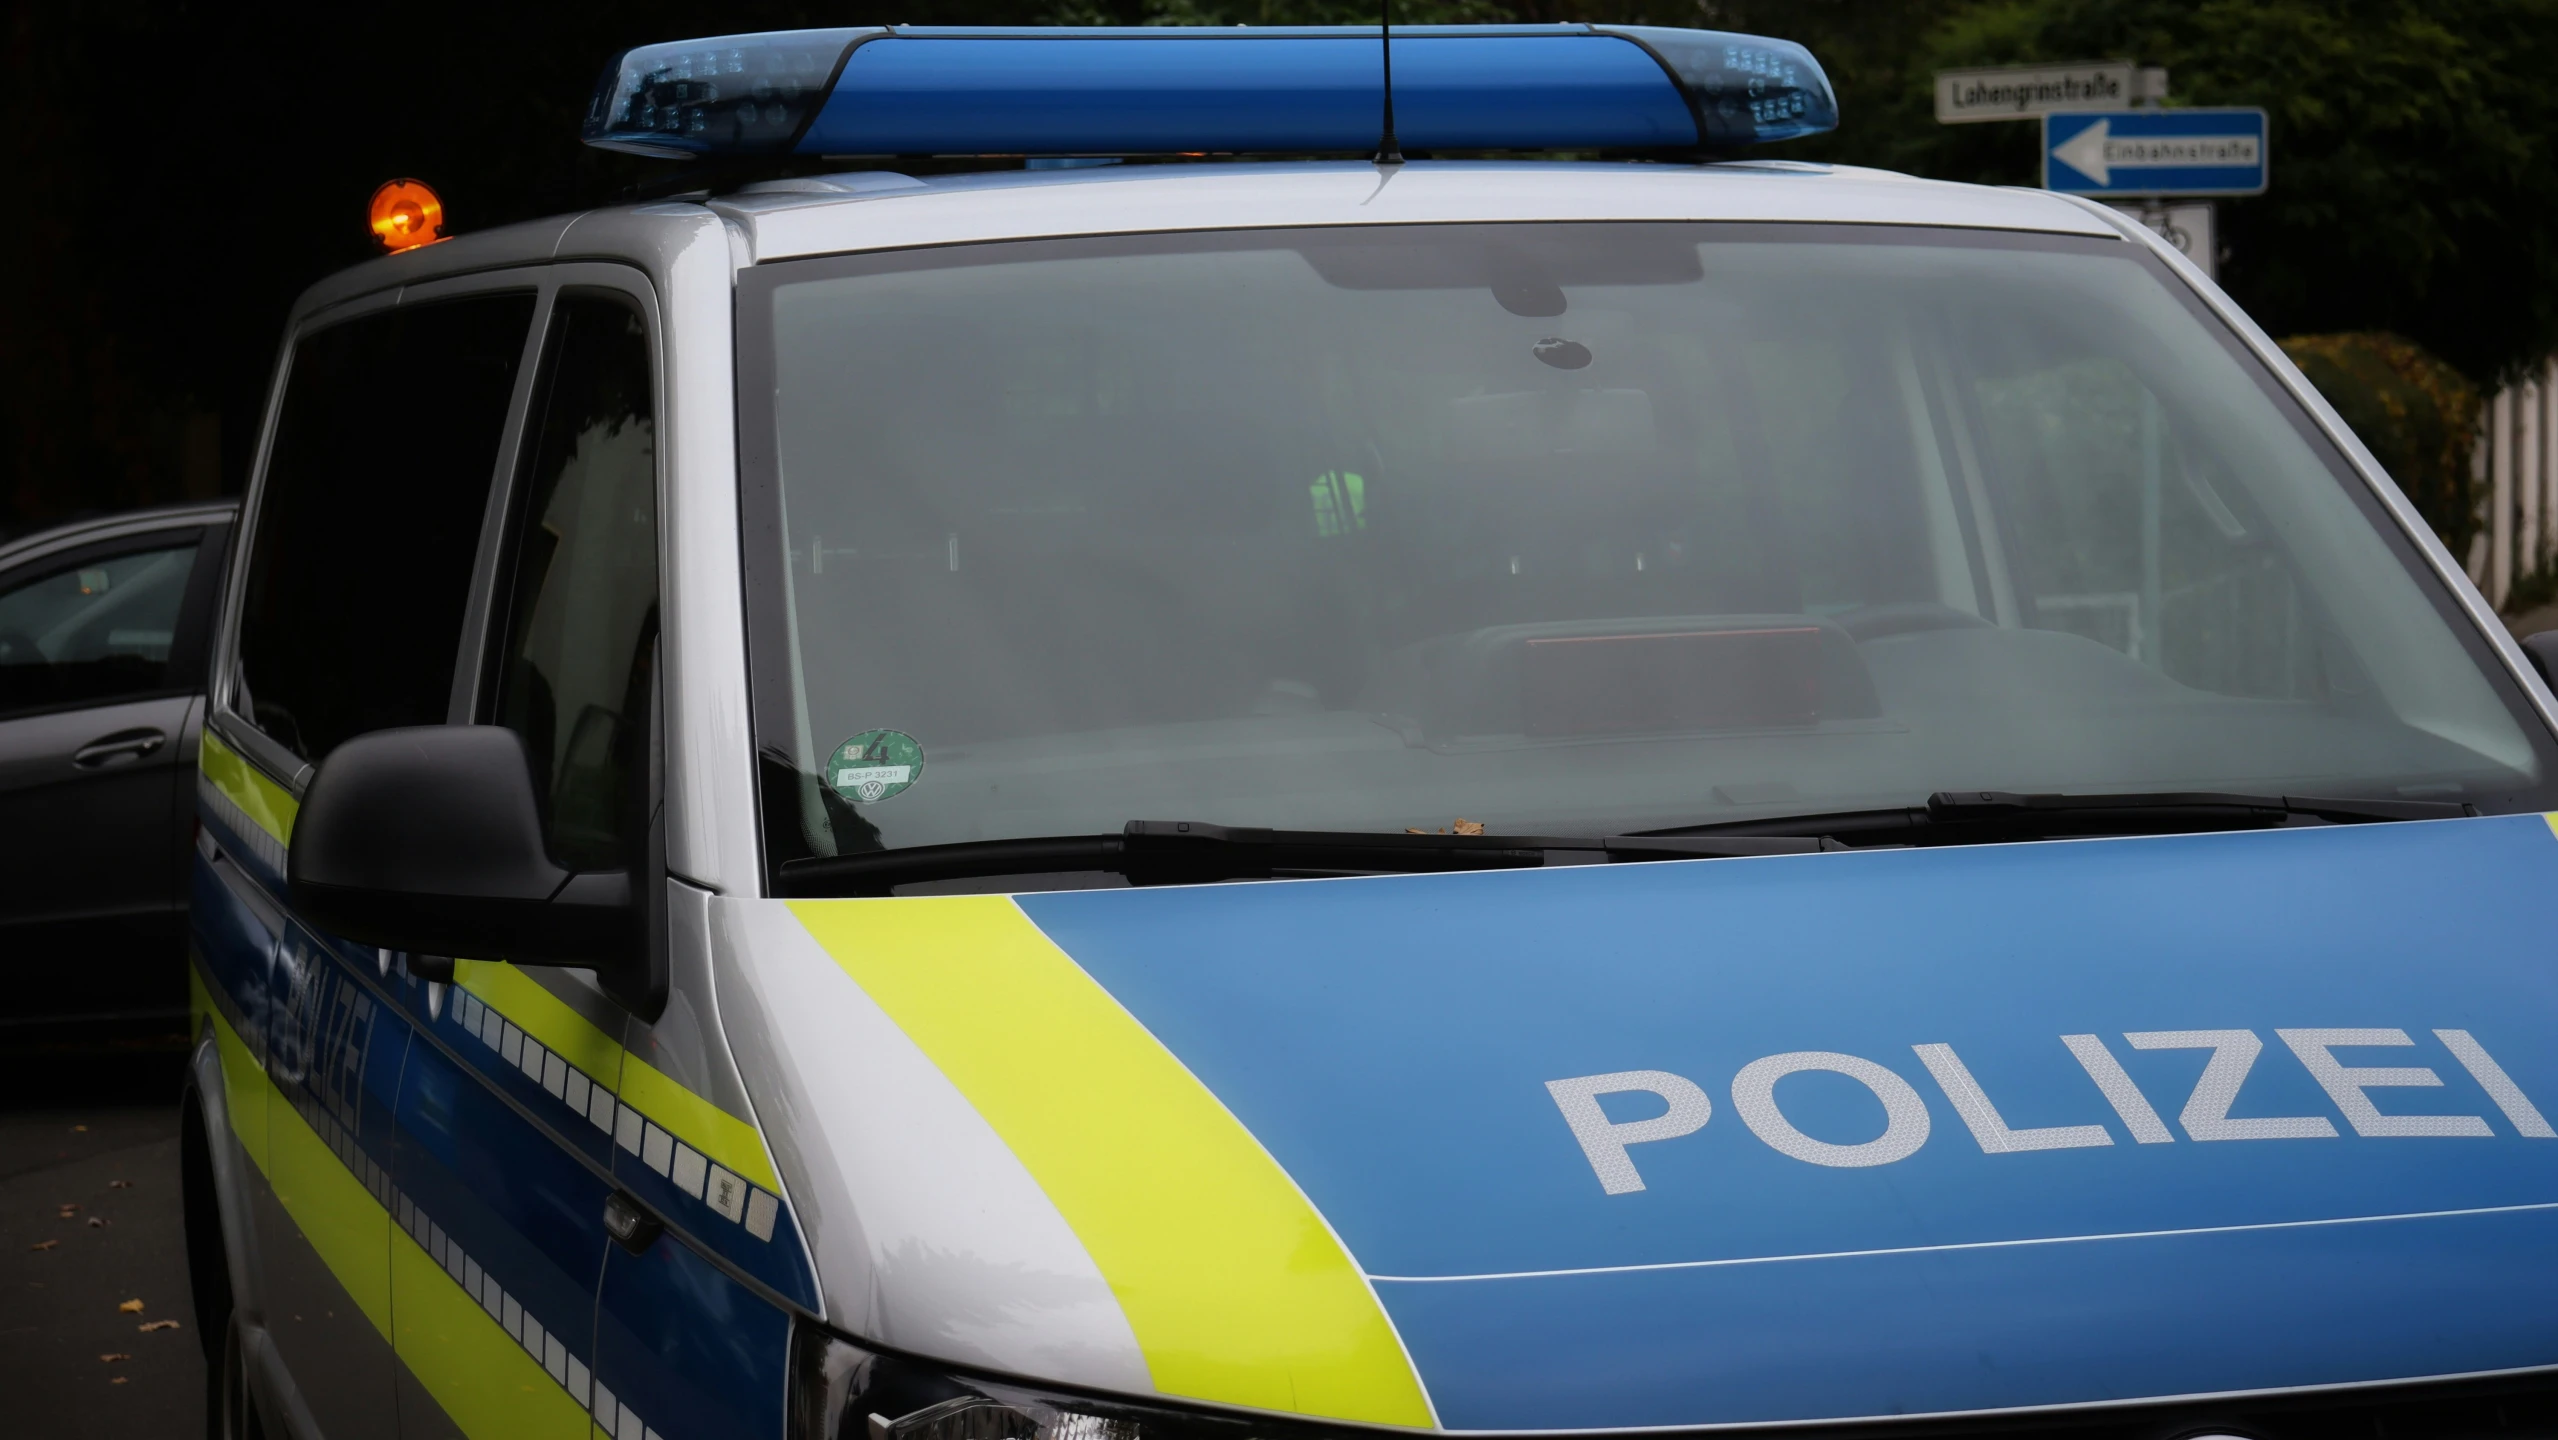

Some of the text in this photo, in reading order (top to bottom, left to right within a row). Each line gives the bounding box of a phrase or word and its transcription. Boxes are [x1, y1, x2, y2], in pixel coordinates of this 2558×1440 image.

[1951, 72, 2120, 112] Lohengrinstraße
[2103, 139, 2253, 162] Einbahnstraße
[863, 733, 890, 765] 4
[847, 770, 898, 781] BS-P 3231
[287, 943, 377, 1138] POLIZEI
[1544, 1028, 2557, 1196] POLIZEI
